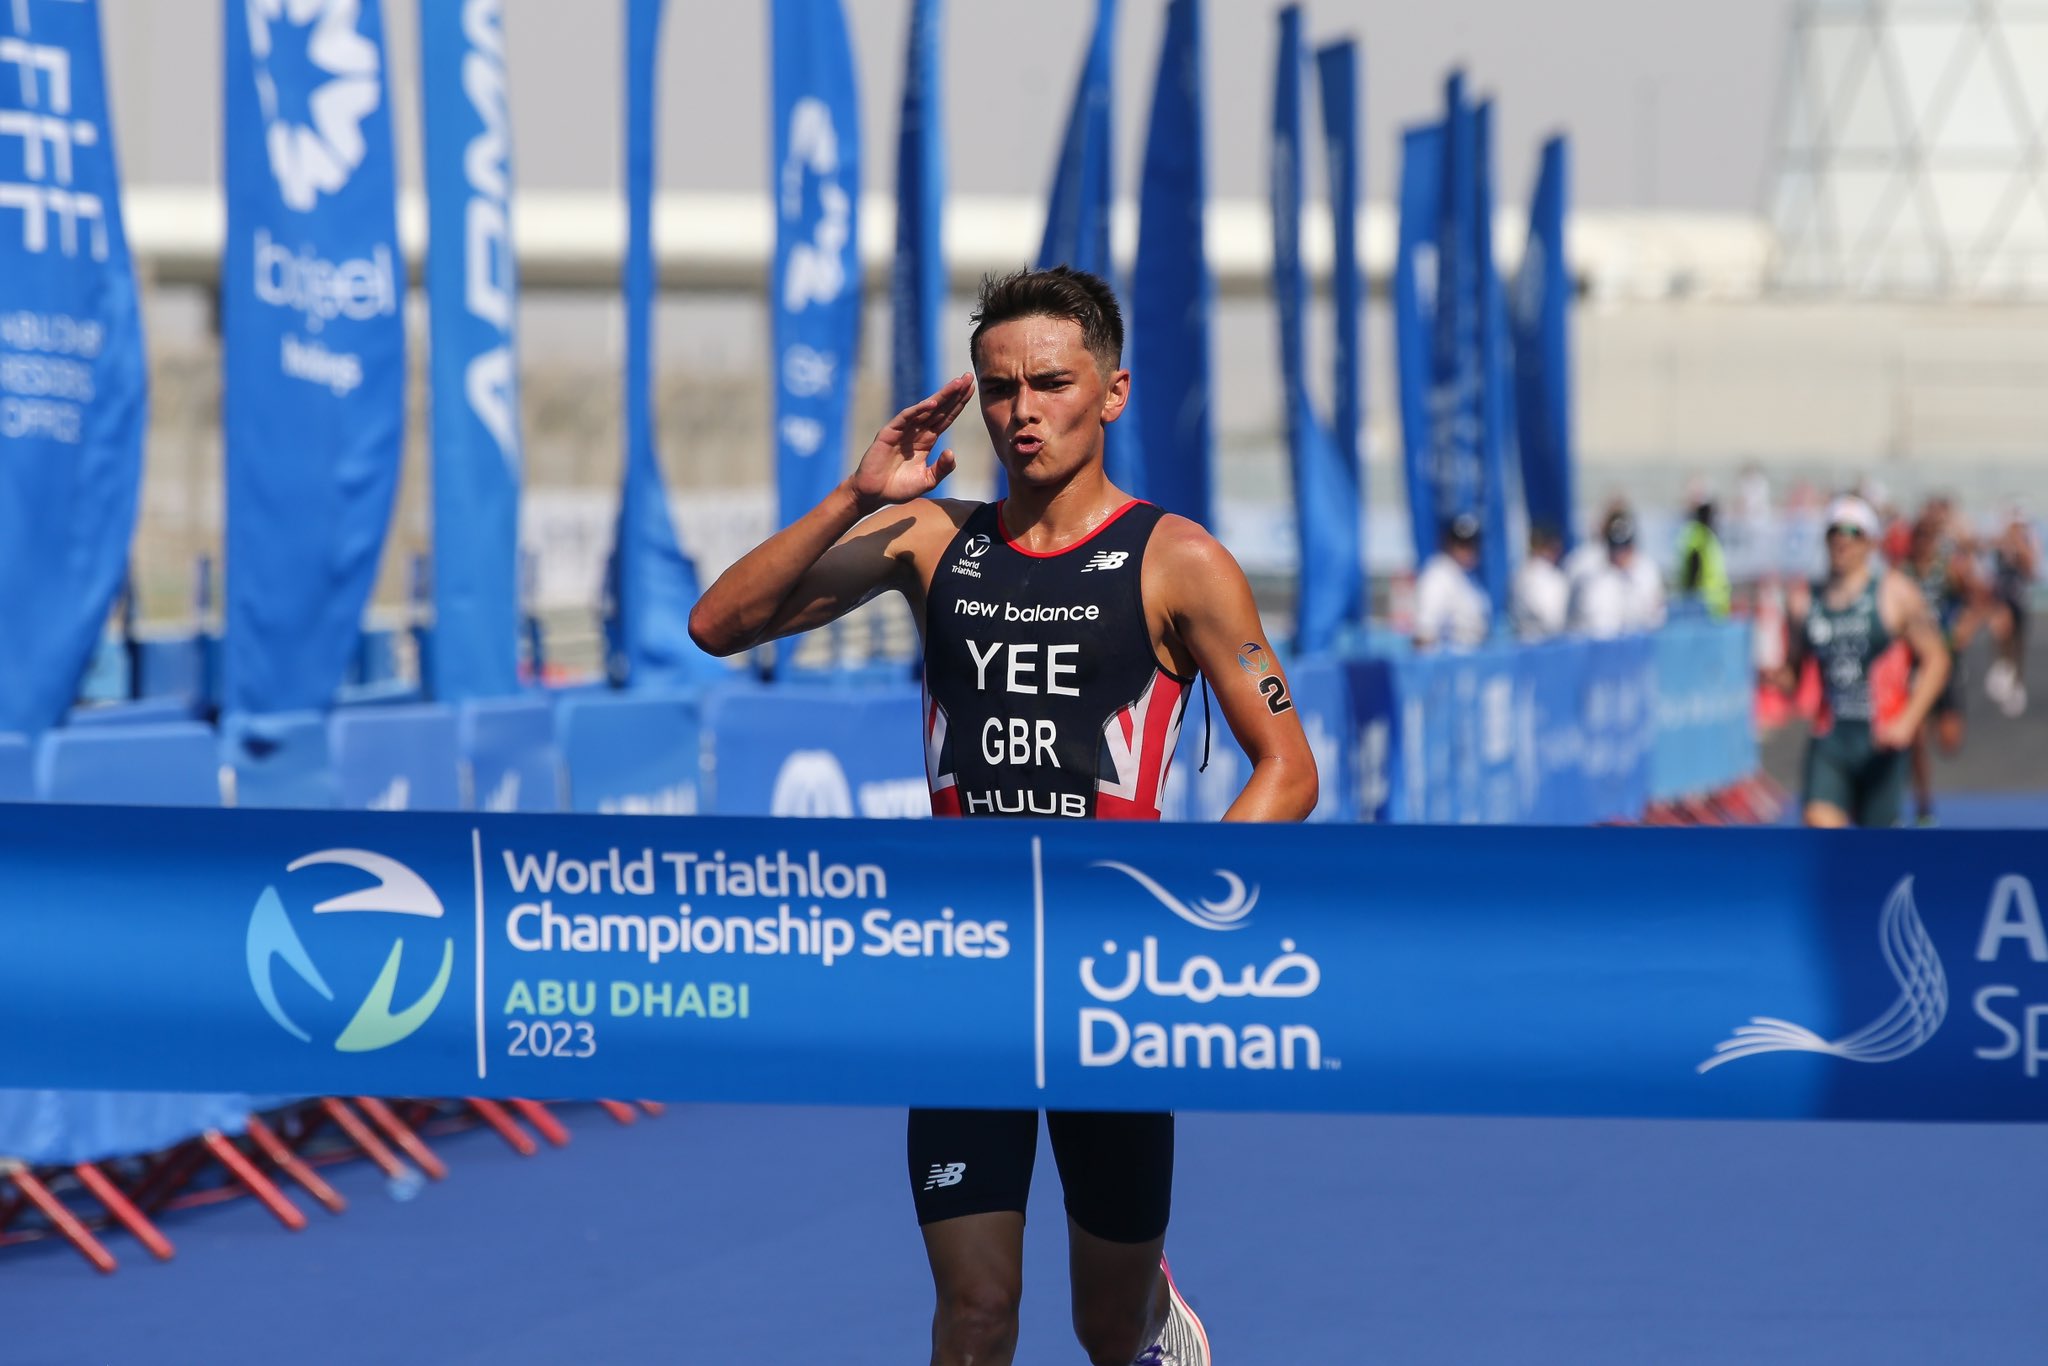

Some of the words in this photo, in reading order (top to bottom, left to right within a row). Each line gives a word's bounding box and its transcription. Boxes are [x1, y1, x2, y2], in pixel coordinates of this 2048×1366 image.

[951, 565, 982, 579] Triathlon
[959, 558, 980, 570] World
[954, 598, 1000, 618] new
[1004, 601, 1100, 623] balance
[965, 638, 1080, 697] YEE
[1257, 674, 1294, 716] 2
[981, 716, 1061, 769] GBR
[966, 789, 1086, 818] HUUB
[502, 847, 656, 896] World
[661, 850, 887, 899] Triathlon
[505, 900, 855, 967] Championship
[861, 907, 1011, 959] Series
[1079, 935, 1321, 1004] ضمان
[504, 979, 598, 1017] ABU
[610, 981, 750, 1019] DHABI
[507, 1019, 598, 1059] 2023
[1078, 1006, 1322, 1070] Daman
